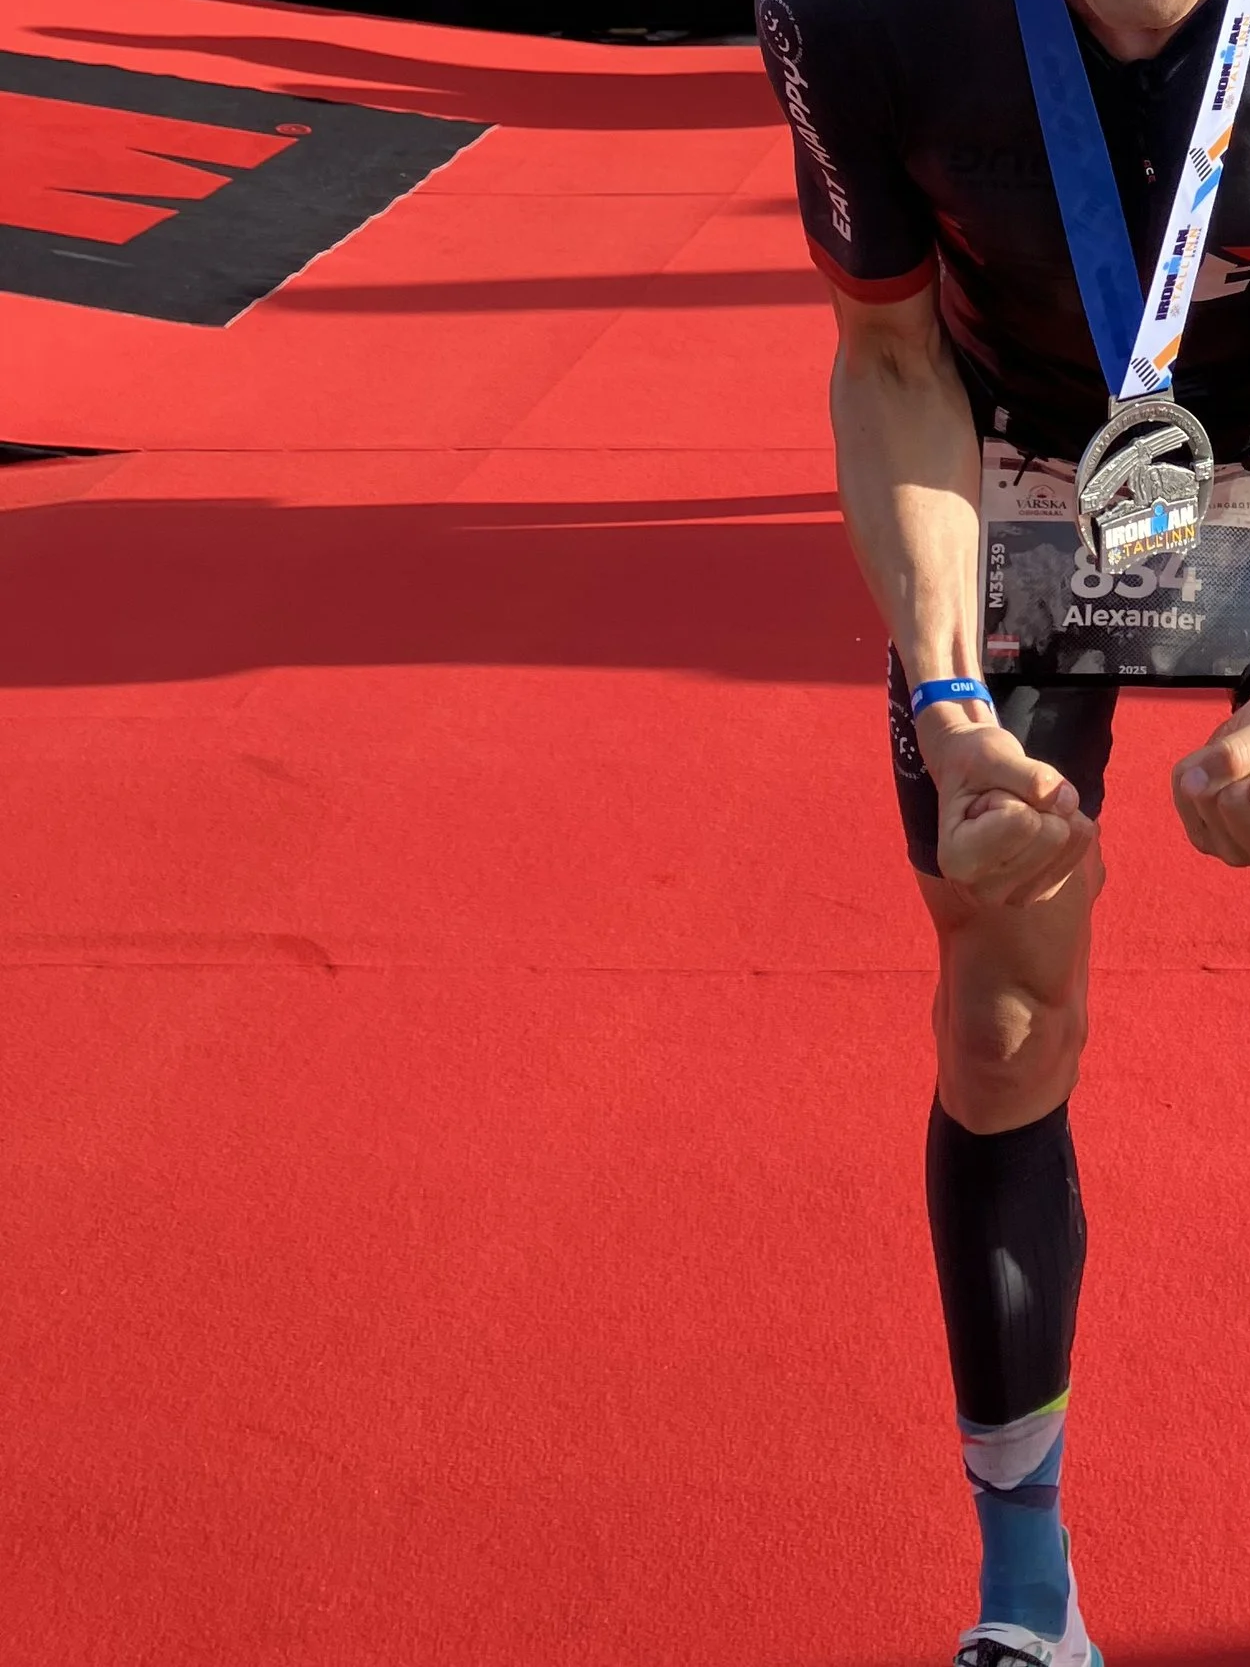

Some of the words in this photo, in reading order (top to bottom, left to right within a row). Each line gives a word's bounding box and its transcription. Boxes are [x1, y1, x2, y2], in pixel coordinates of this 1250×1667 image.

[1211, 17, 1243, 111] IRONMAN
[782, 55, 837, 172] HAPPY
[822, 168, 851, 243] EAT
[1154, 229, 1190, 321] IRONMAN
[1172, 228, 1199, 302] TALLINN
[1105, 504, 1196, 550] IRONMAN
[1123, 525, 1196, 556] TALLINN
[989, 542, 1006, 610] M35-39
[1062, 603, 1206, 632] Alexander
[951, 682, 974, 692] IND
[1118, 665, 1148, 675] 2025
